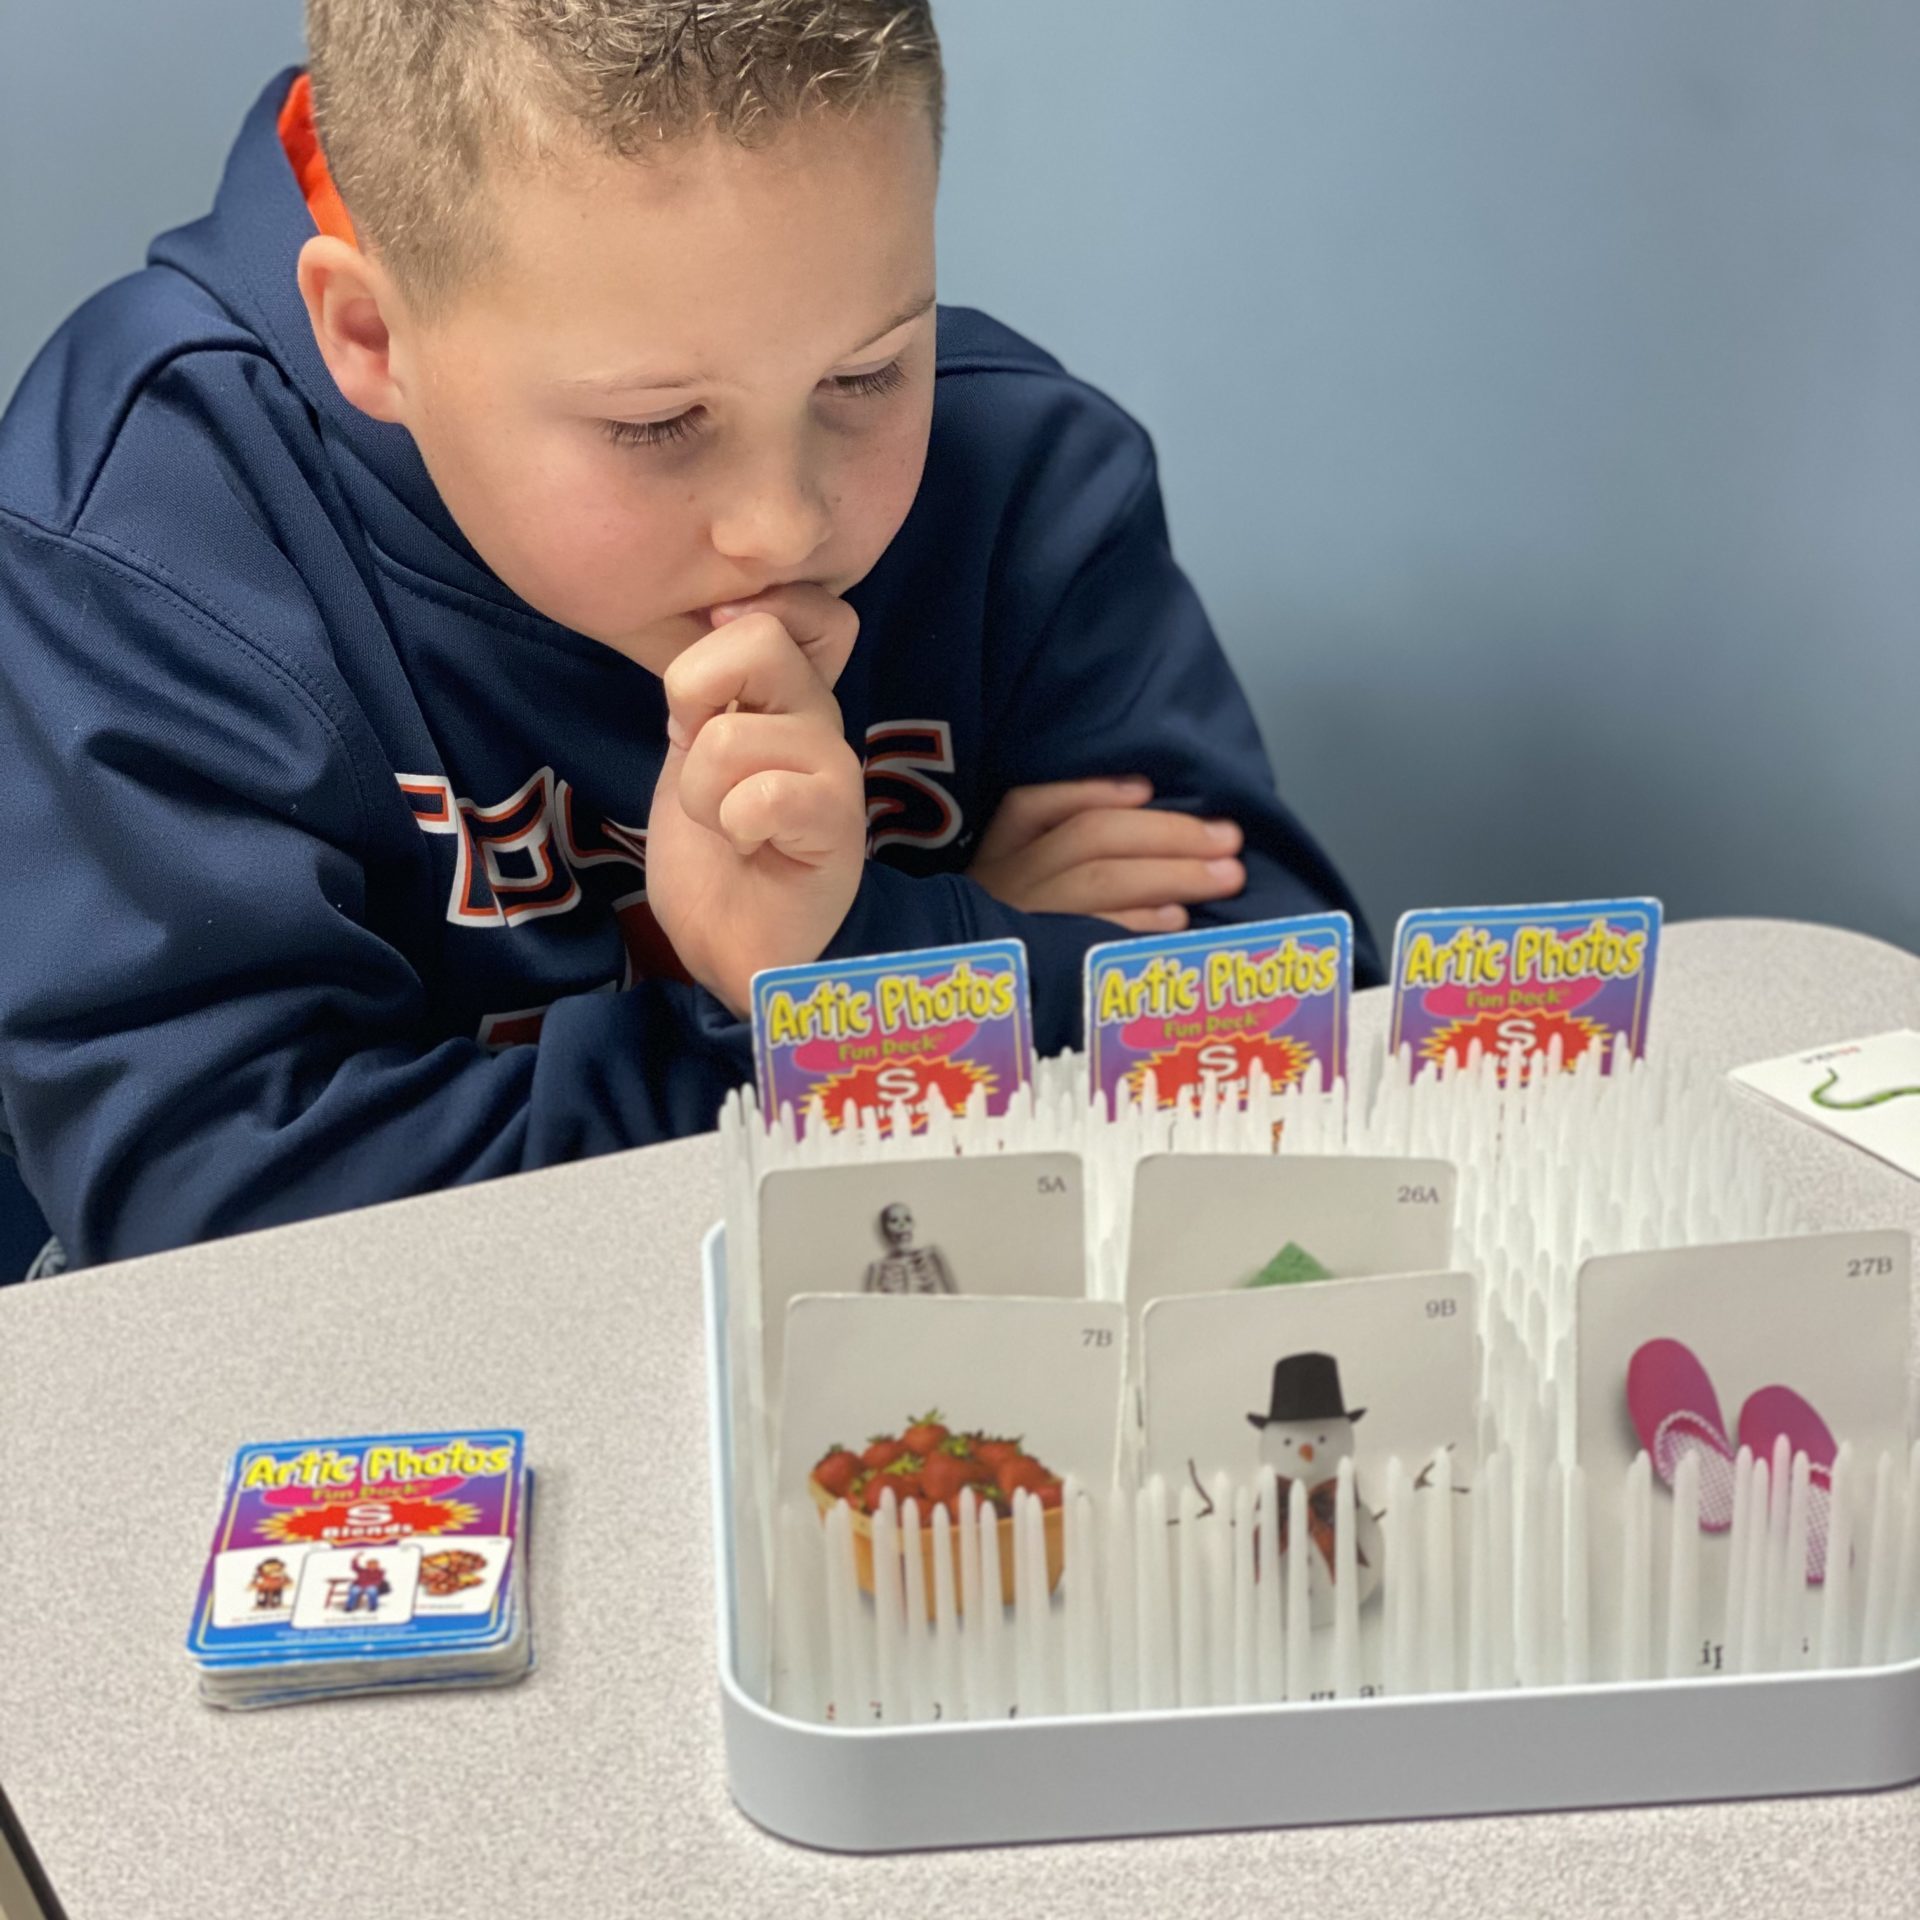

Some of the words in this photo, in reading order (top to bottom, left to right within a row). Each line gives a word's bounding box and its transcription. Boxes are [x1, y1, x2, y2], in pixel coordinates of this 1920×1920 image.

[1403, 926, 1507, 987] Artic
[1512, 918, 1646, 983] Photos
[1098, 957, 1198, 1023] Artic
[1206, 937, 1339, 1010] Photos
[766, 980, 871, 1048] Artic
[877, 962, 1016, 1033] Photos
[1466, 992, 1502, 1008] Fun
[1163, 1021, 1201, 1039] Fun
[1495, 1019, 1537, 1051] S
[838, 1043, 877, 1062] Fun
[1198, 1044, 1239, 1078] S
[876, 1067, 919, 1101] S
[1037, 1175, 1067, 1194] 5A
[1397, 1185, 1440, 1205] 26A
[1846, 1256, 1893, 1278] 27B
[1425, 1298, 1457, 1319] 9B
[1082, 1328, 1114, 1348] 7B
[242, 1450, 358, 1489] Artic
[363, 1439, 515, 1483] Photos
[346, 1503, 393, 1526] S
[321, 1523, 413, 1540] Blends
